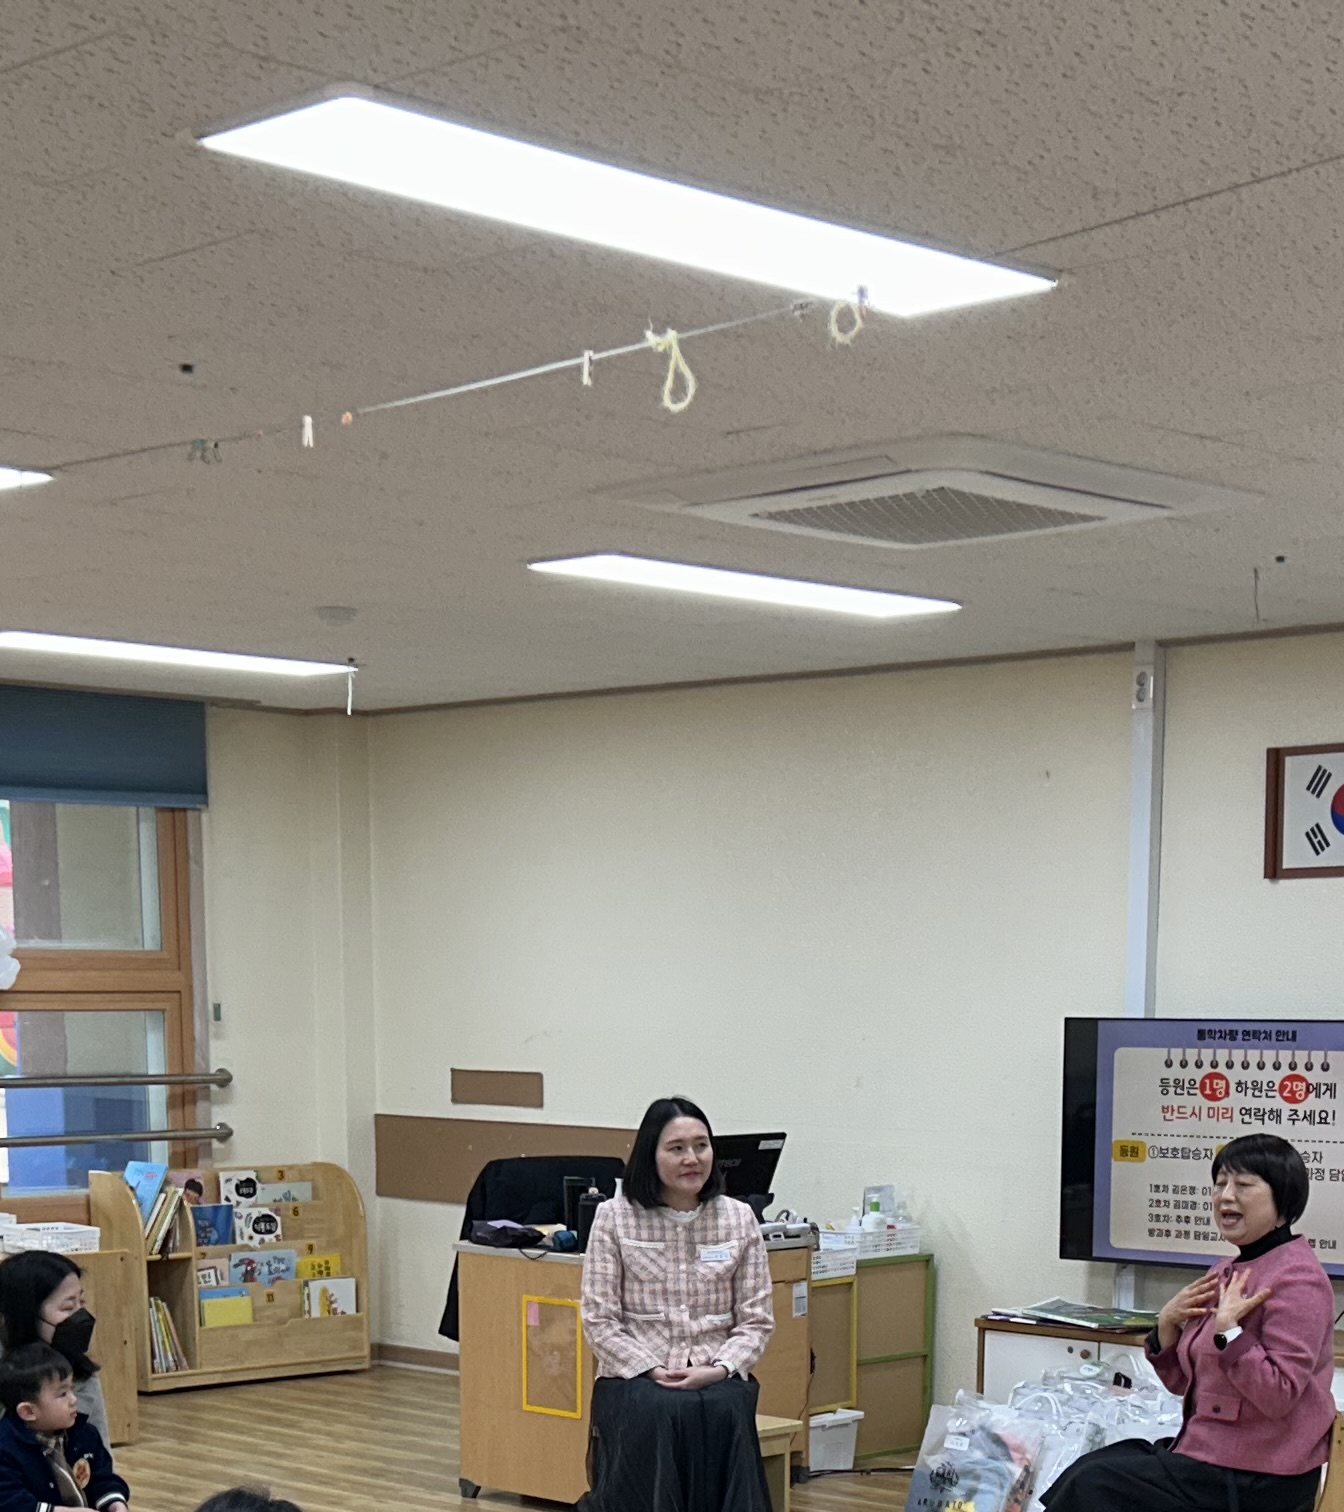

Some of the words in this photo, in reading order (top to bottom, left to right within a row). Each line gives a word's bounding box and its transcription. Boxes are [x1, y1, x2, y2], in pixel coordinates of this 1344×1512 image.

[1241, 1029, 1272, 1042] 연락처
[1275, 1030, 1297, 1042] 안내
[1159, 1078, 1198, 1097] 등원은
[1235, 1080, 1277, 1098] 하원은
[1161, 1104, 1202, 1122] 반드시
[1207, 1105, 1234, 1123] 미리
[1239, 1106, 1282, 1125] 연락해
[1287, 1109, 1336, 1127] 주세요!
[1301, 1150, 1323, 1164] 승자
